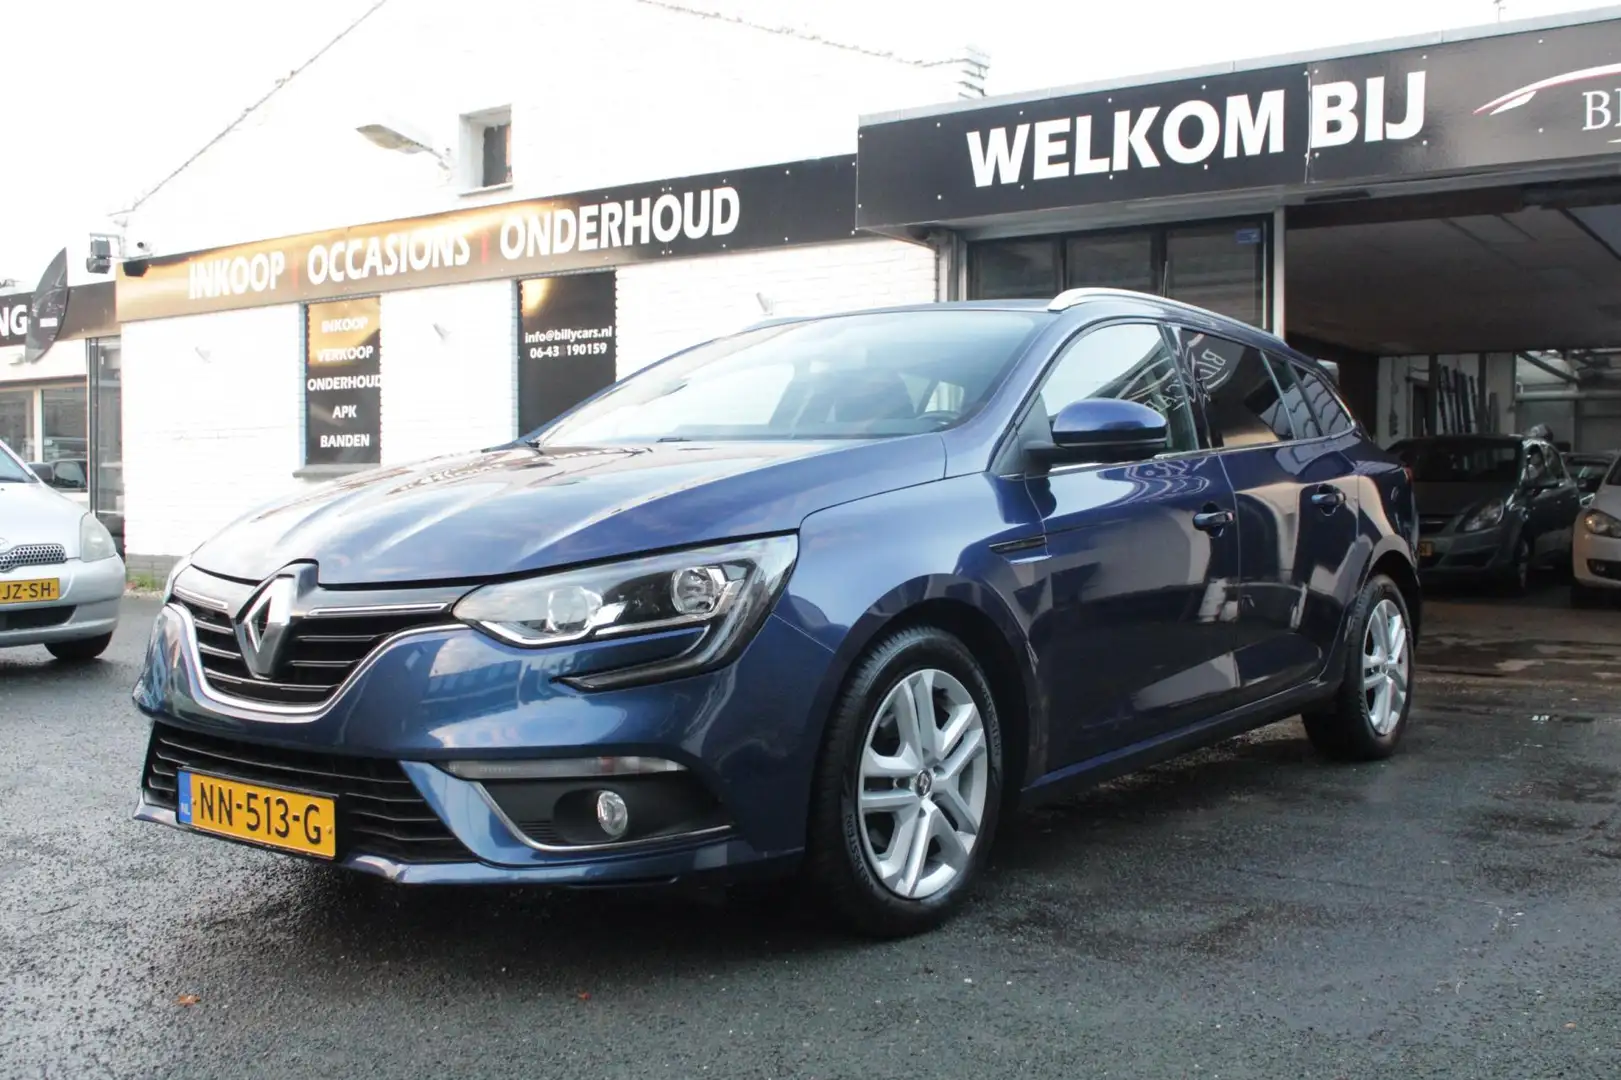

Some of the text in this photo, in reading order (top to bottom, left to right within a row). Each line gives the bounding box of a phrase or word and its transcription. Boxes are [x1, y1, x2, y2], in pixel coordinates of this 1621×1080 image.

[966, 70, 1426, 187] WELKOM BIJ
[189, 186, 740, 300] INKOOP OCCASIONS ONDERHOUD
[321, 316, 368, 333] INKOOP
[524, 325, 613, 343] info@billycars.nl
[316, 345, 374, 361] VERKOOP
[567, 342, 607, 356] 190159
[307, 374, 381, 391] ONDERHOUD
[332, 405, 357, 418] APK
[320, 433, 370, 448] BANDEN
[2, 582, 51, 600] JZ-SH
[200, 782, 321, 845] NN-513-G
